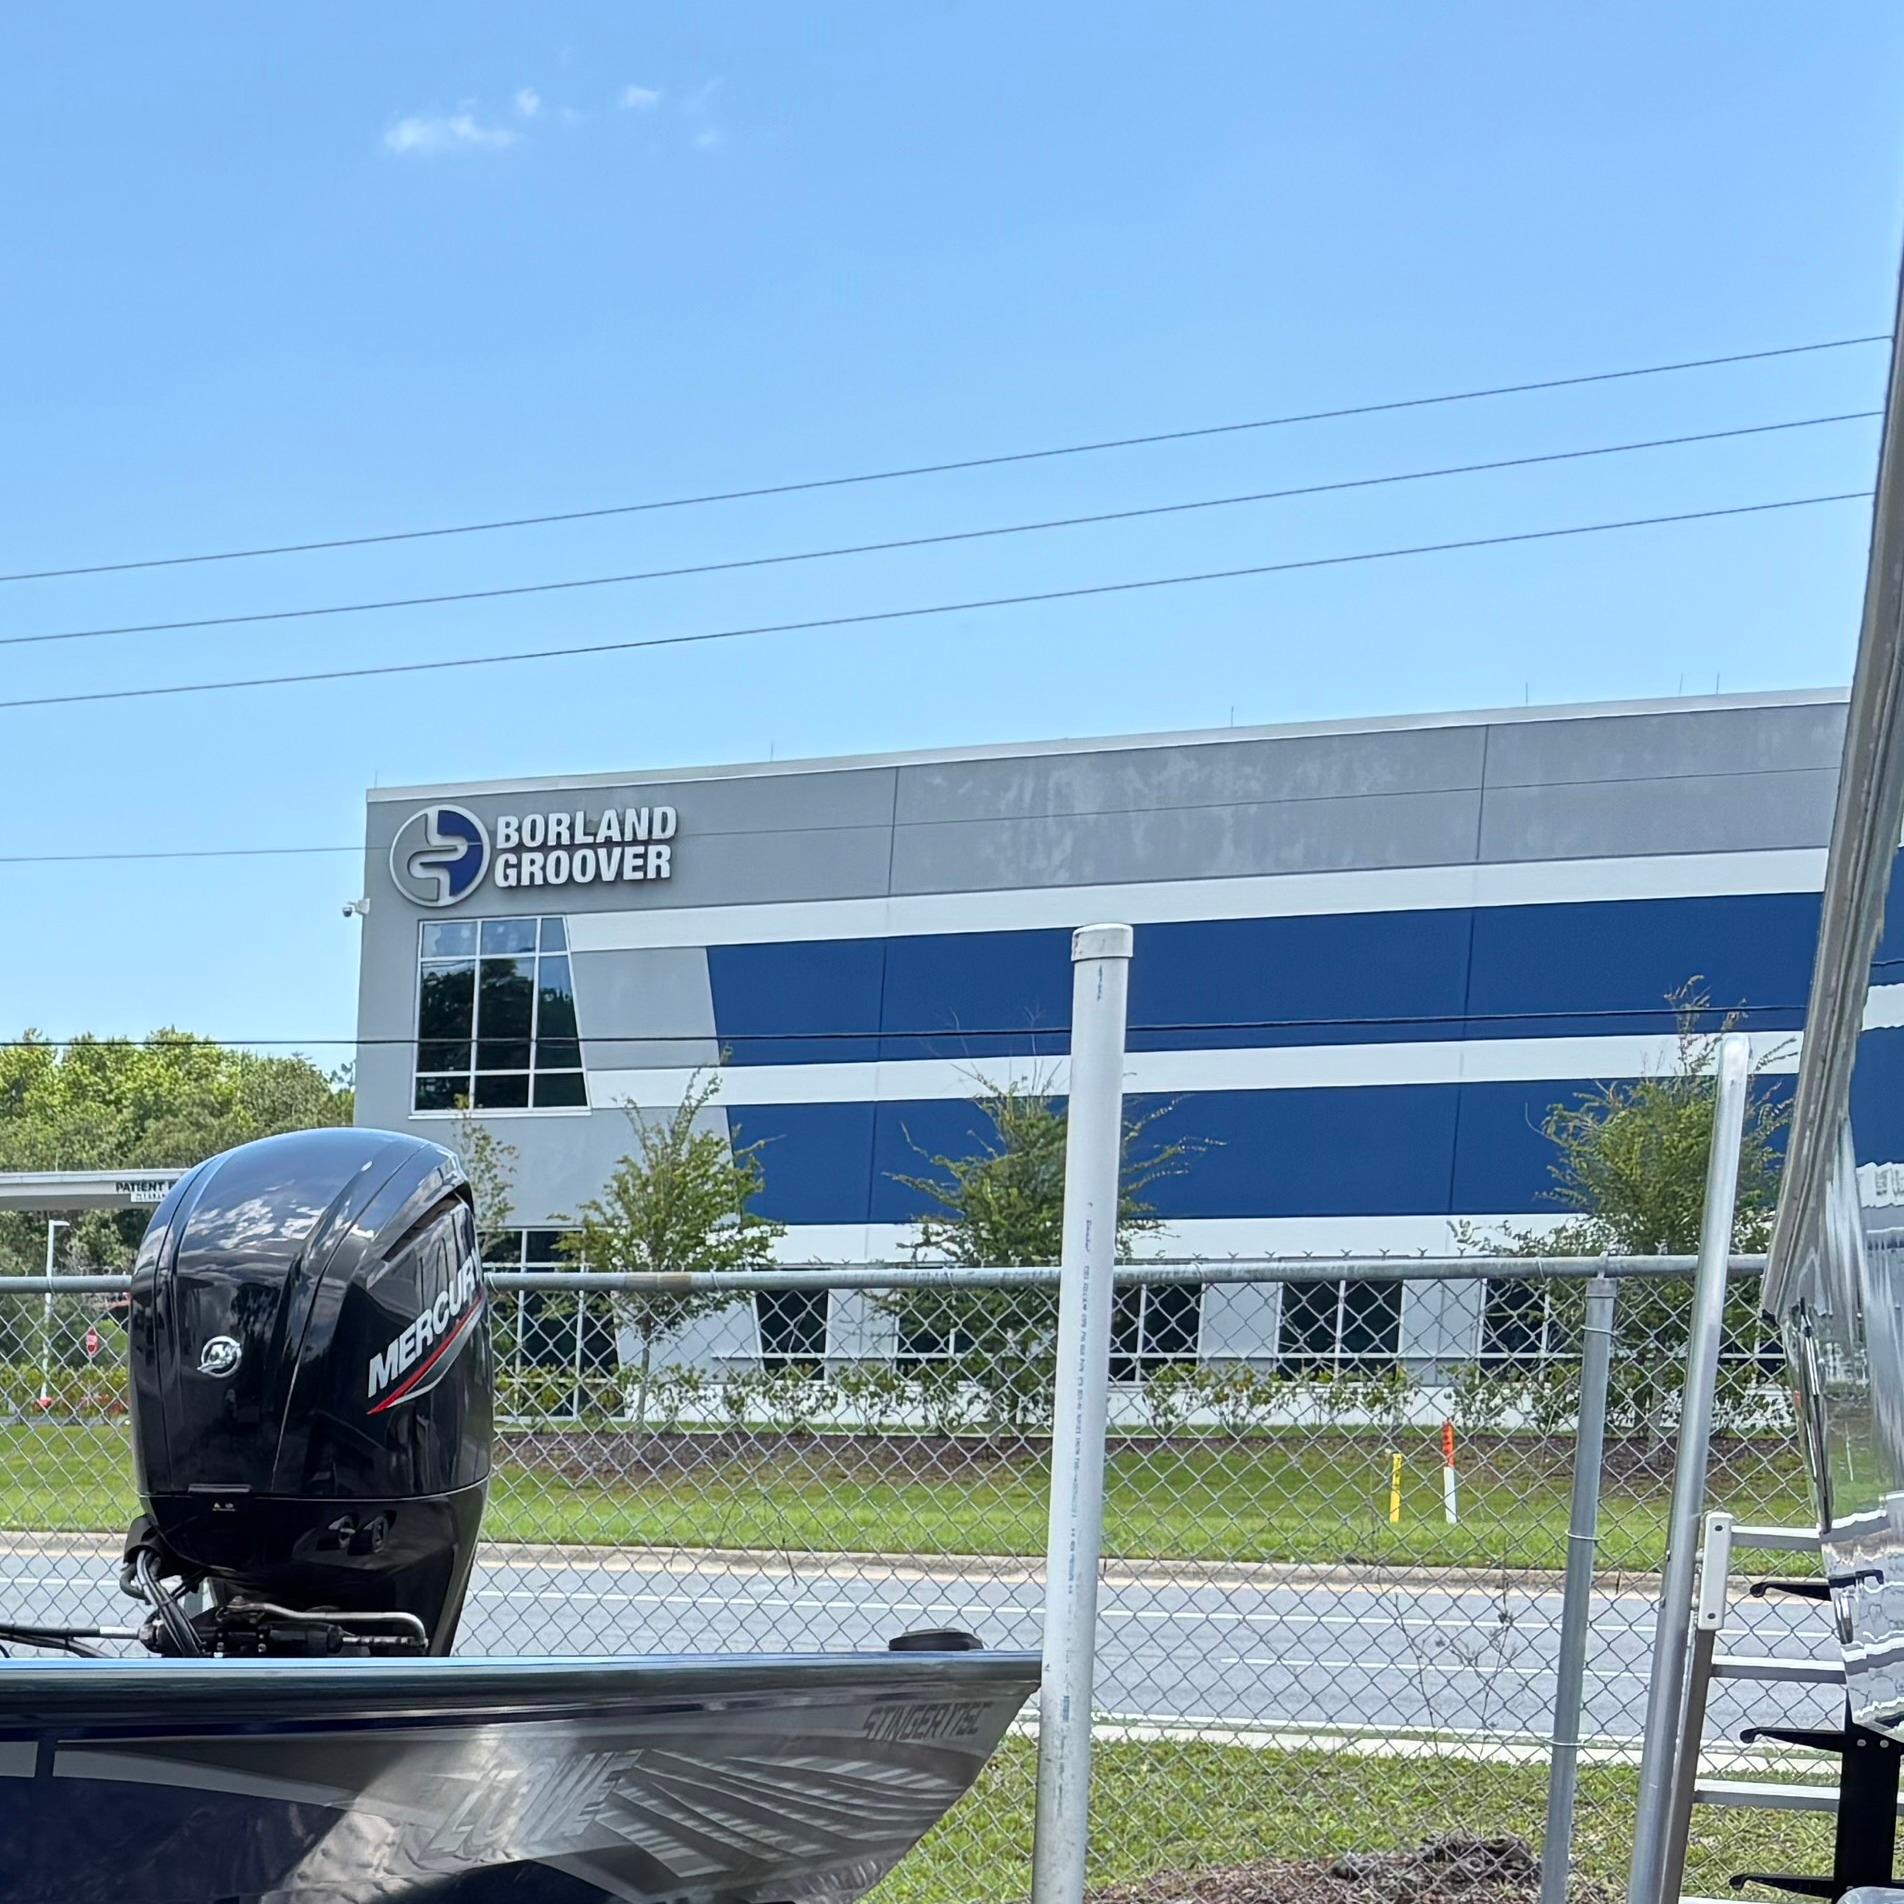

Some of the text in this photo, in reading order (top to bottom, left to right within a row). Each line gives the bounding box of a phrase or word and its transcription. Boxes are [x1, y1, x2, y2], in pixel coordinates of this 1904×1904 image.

[496, 806, 678, 850] BORLAND
[494, 845, 672, 888] GROOVER
[115, 1181, 166, 1193] PATIENT
[863, 1703, 950, 1741] STINGER
